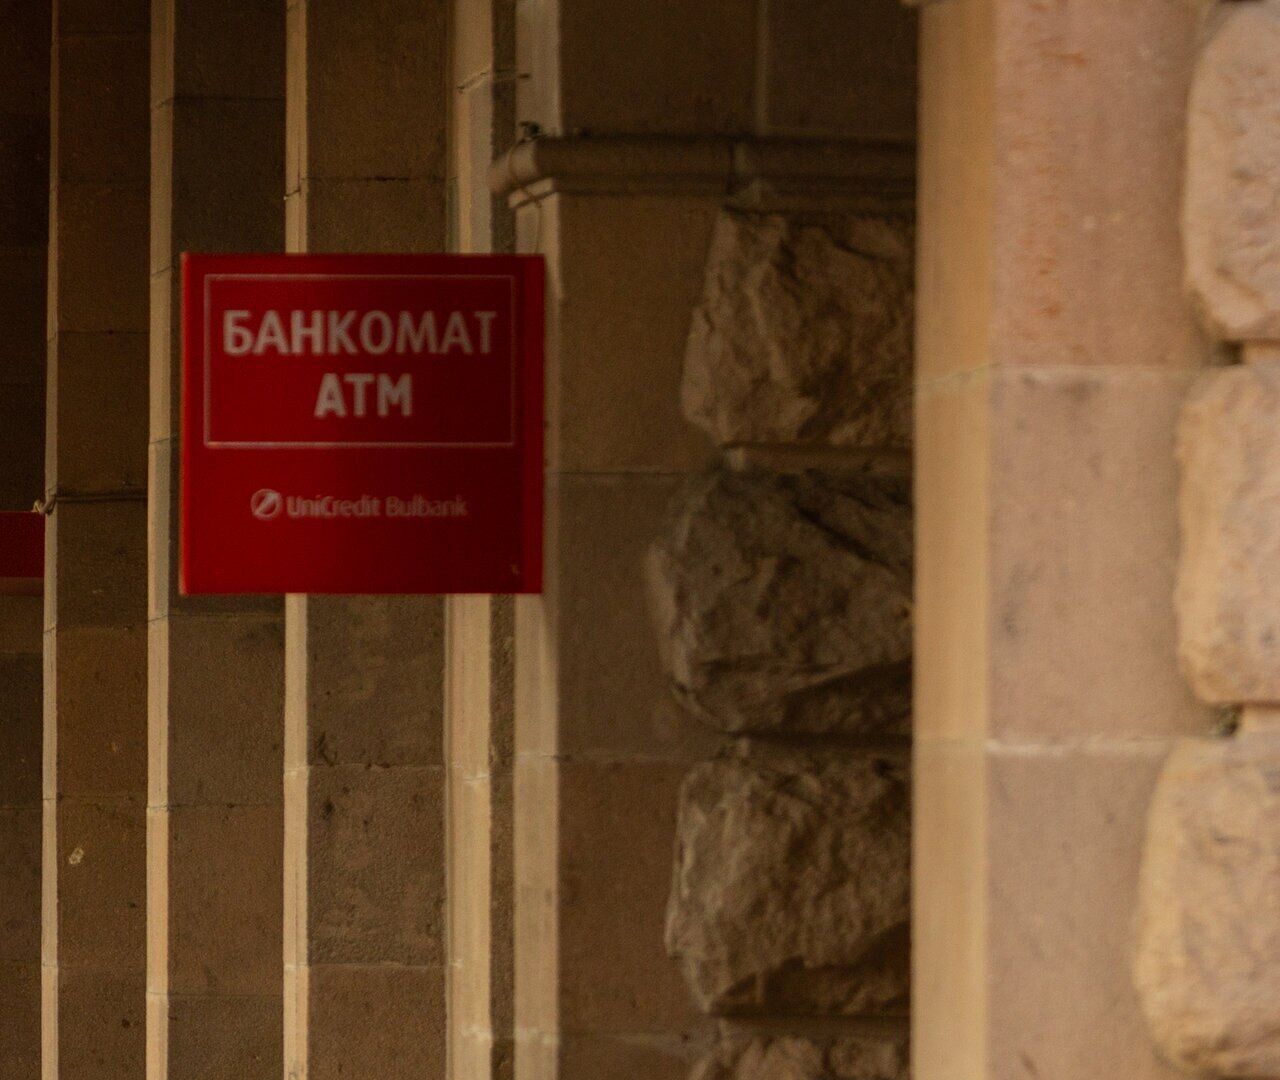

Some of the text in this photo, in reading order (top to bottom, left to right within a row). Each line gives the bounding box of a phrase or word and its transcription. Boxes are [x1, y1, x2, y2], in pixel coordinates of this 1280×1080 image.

[222, 309, 498, 355] БАНКОМАТ
[313, 372, 414, 419] ATM
[286, 494, 468, 518] UniCredit Bulbank
